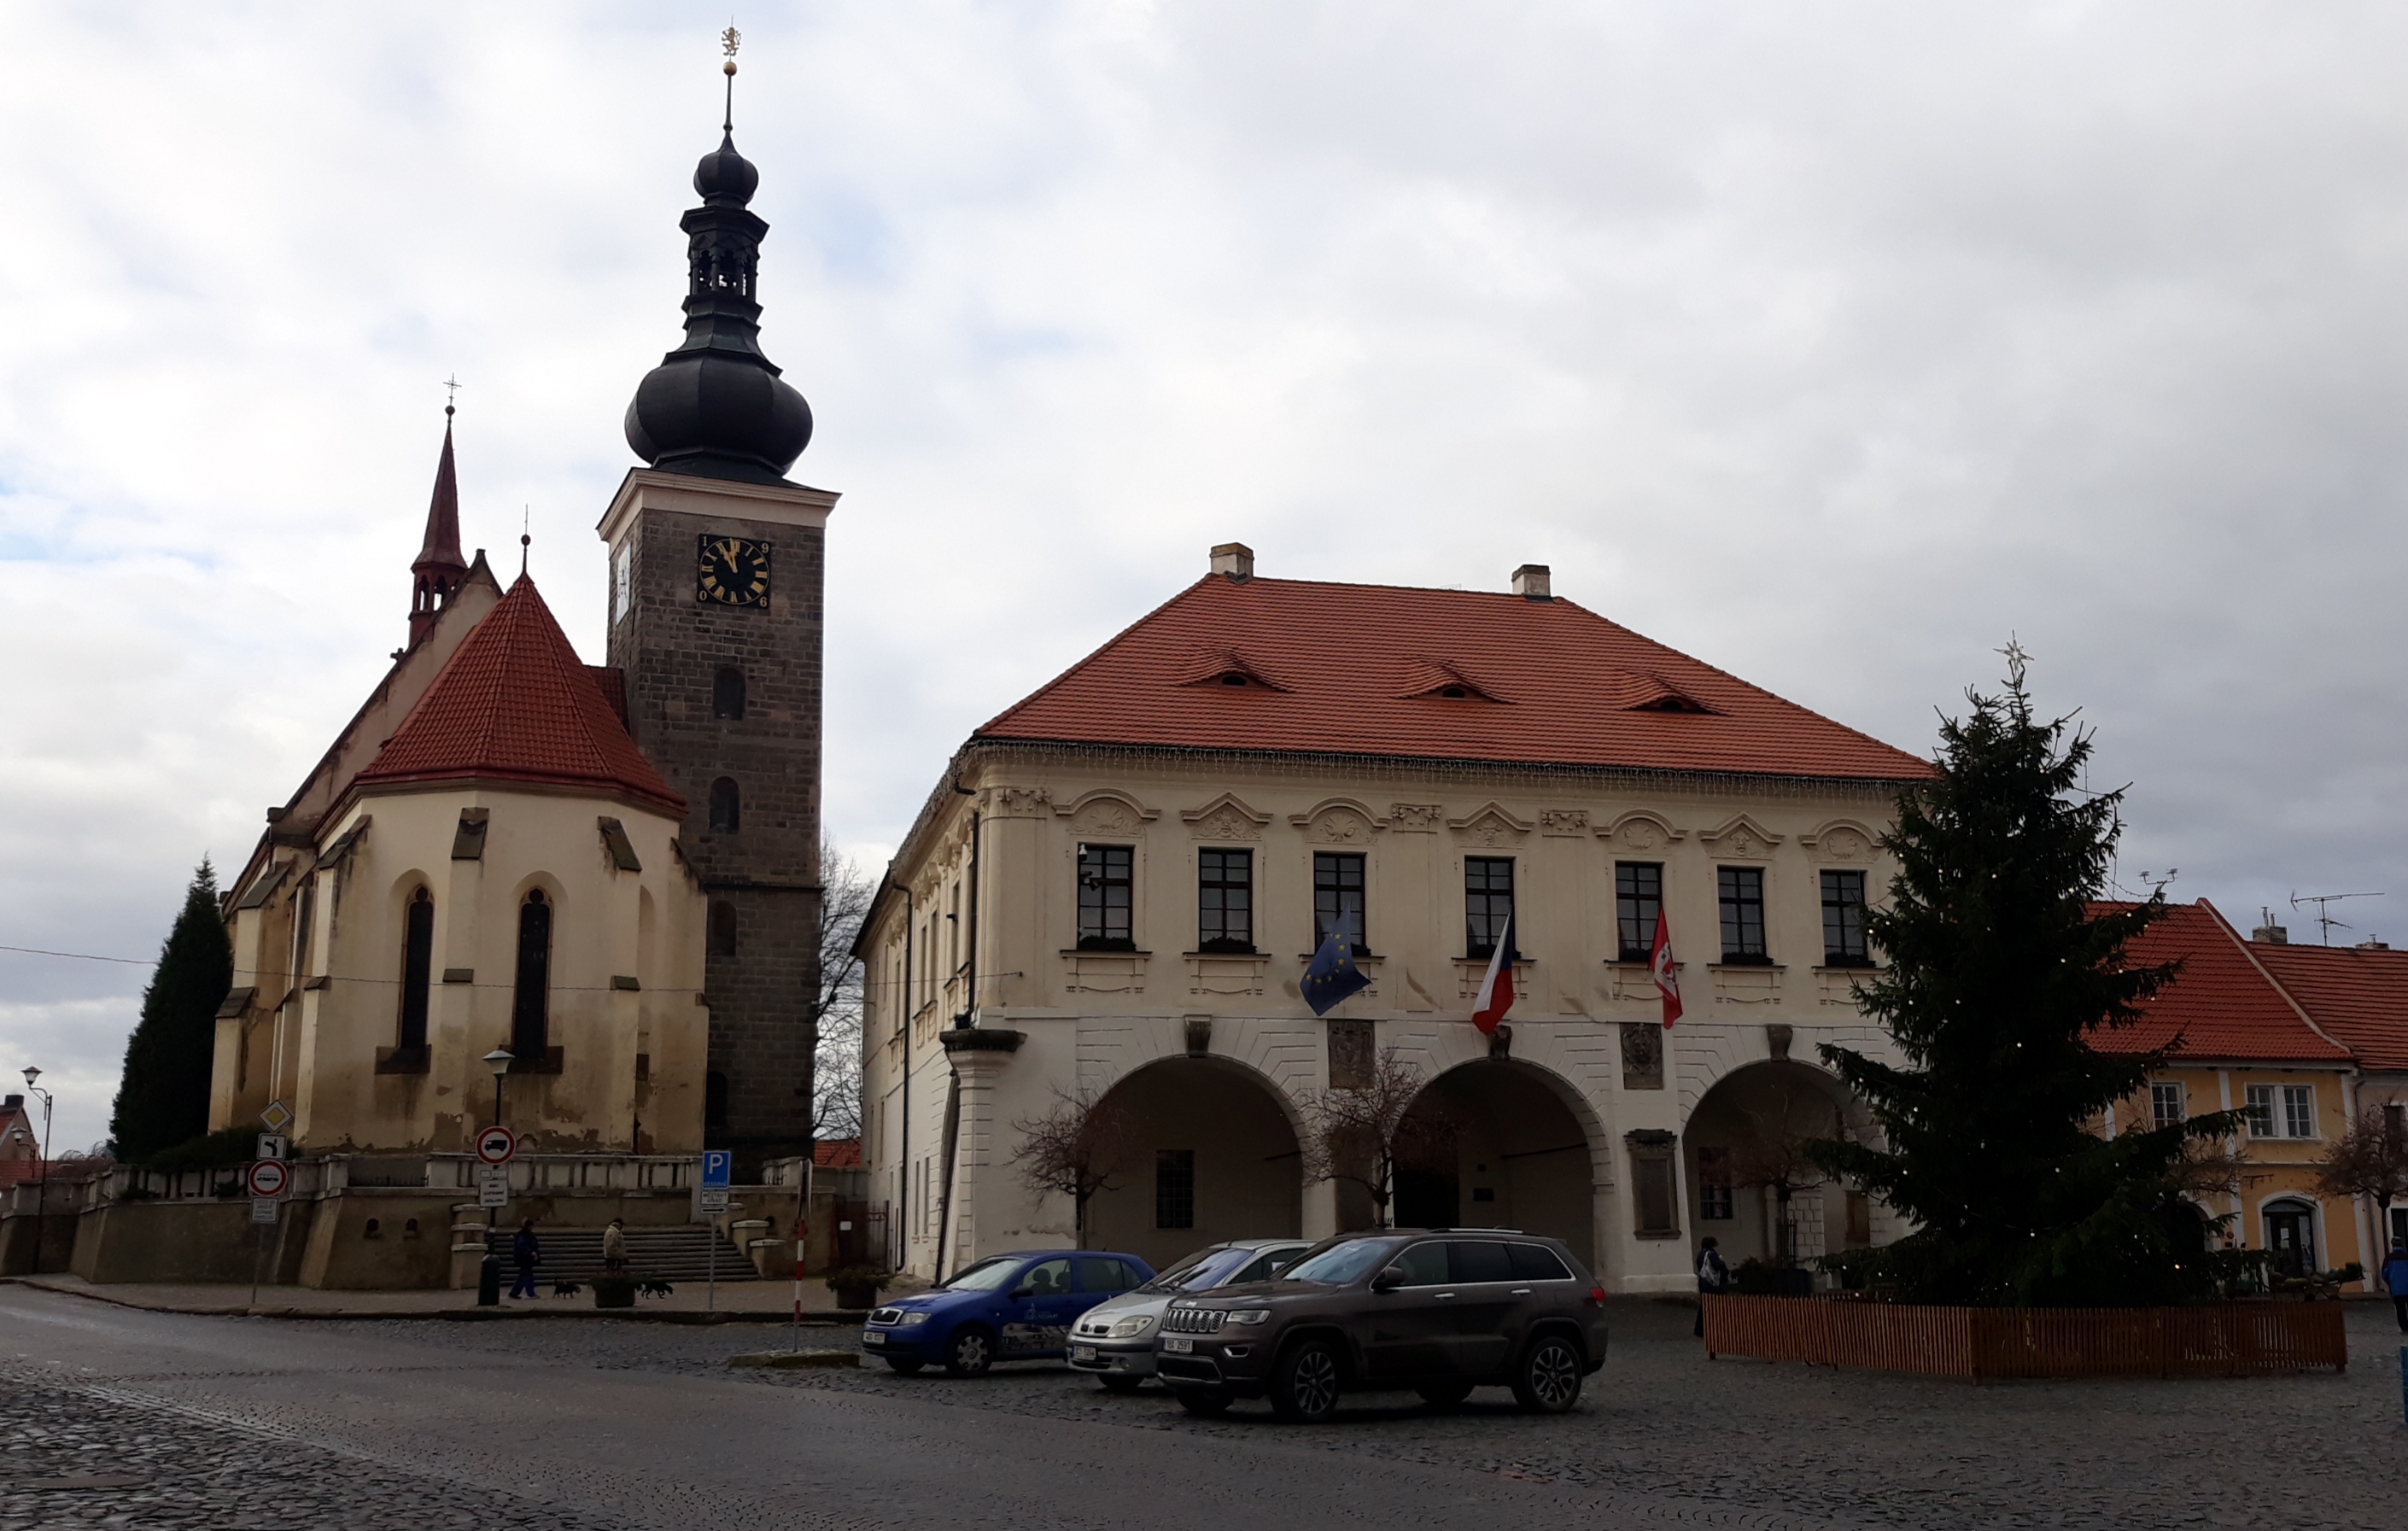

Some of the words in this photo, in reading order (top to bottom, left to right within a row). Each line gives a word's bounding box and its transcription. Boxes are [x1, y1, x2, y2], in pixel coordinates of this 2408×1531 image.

[703, 535, 708, 546] 1
[761, 542, 769, 553] 9
[699, 590, 707, 601] 0
[759, 596, 768, 607] 6
[709, 1154, 724, 1175] P
